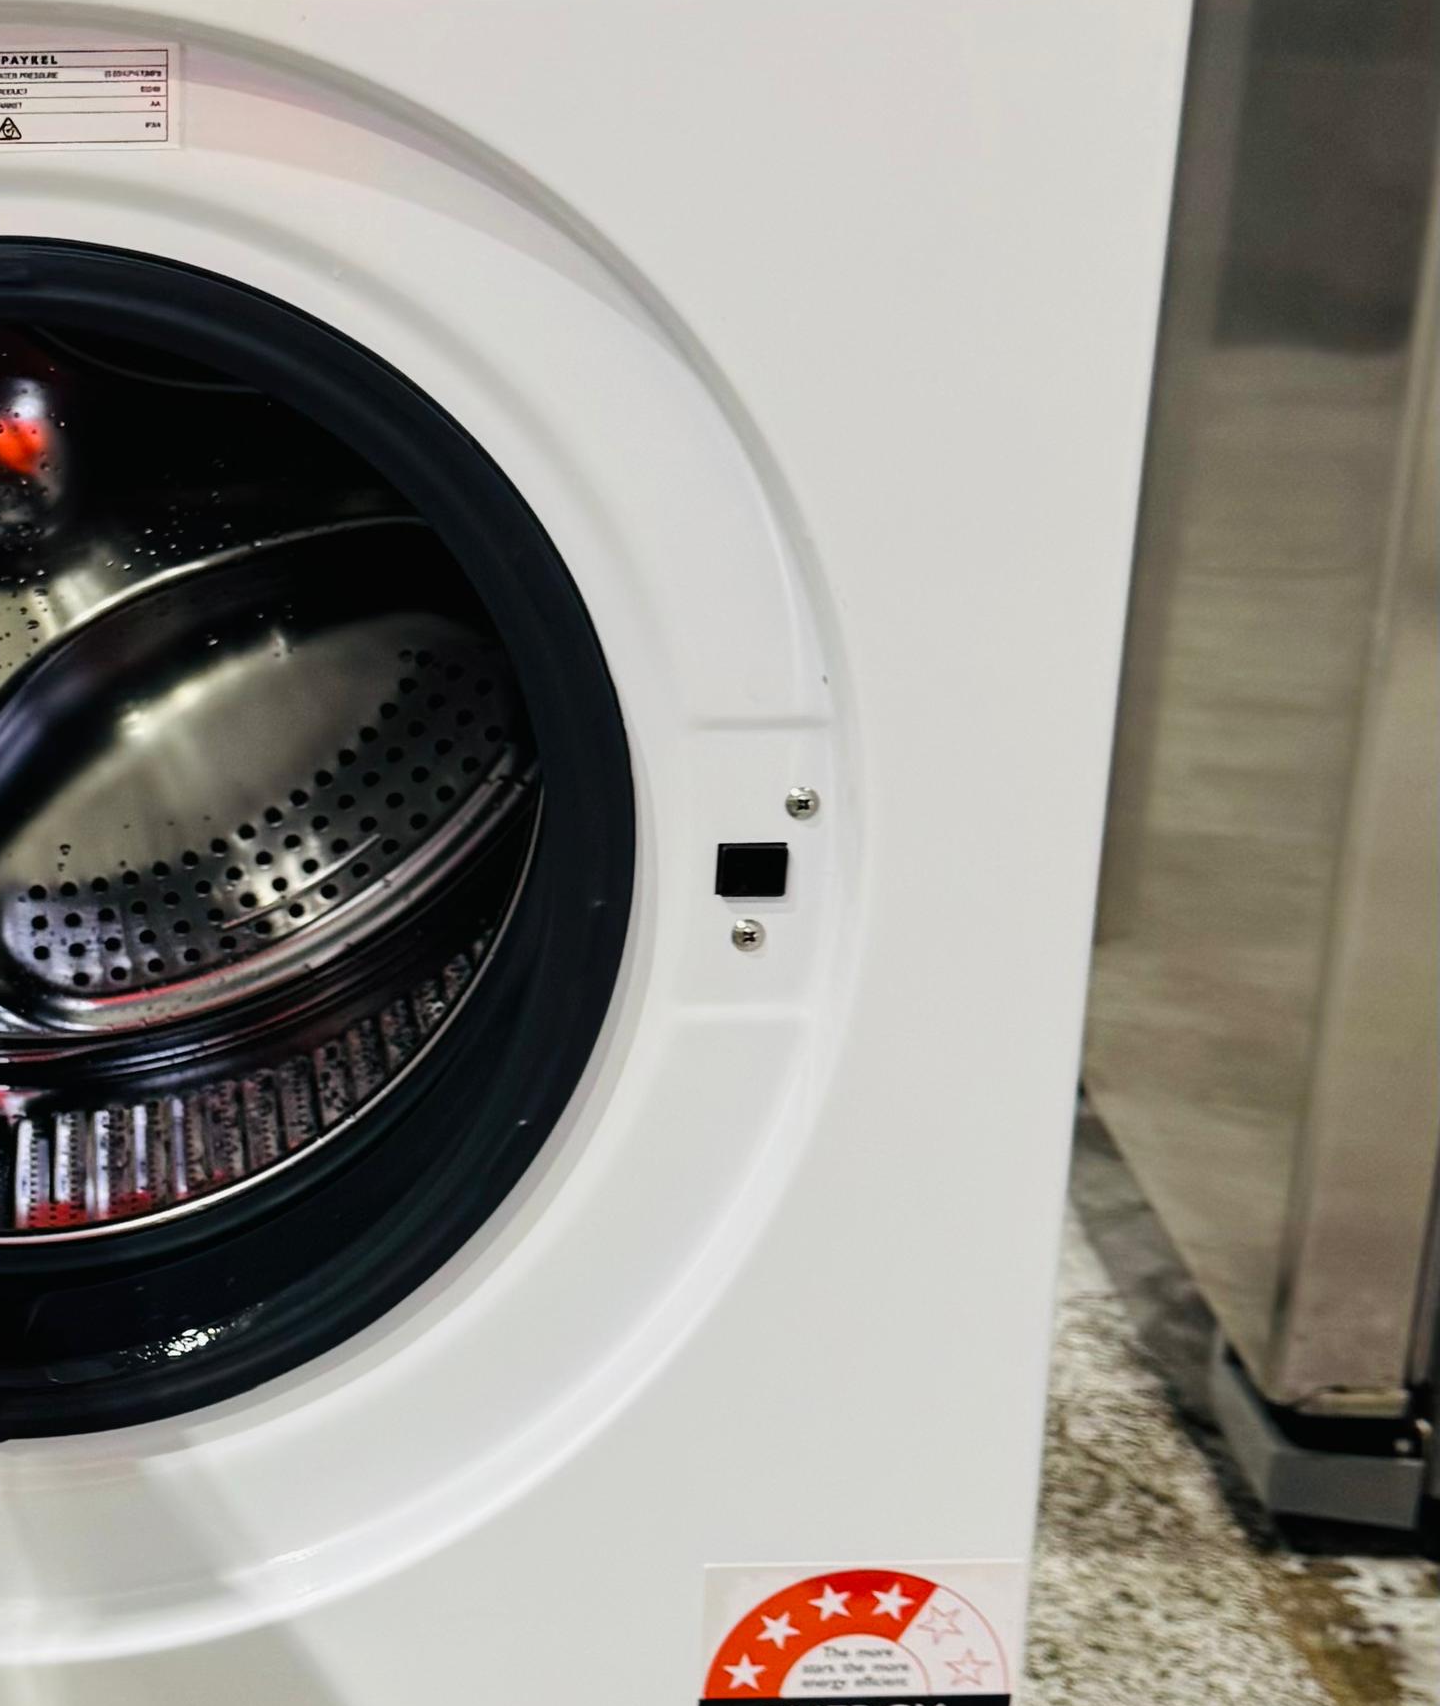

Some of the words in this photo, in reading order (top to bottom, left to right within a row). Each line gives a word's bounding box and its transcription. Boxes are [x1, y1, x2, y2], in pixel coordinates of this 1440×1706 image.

[2, 56, 57, 64] PAYKEL
[824, 1646, 848, 1656] The
[856, 1648, 893, 1656] more
[843, 1663, 864, 1672] the
[801, 1680, 846, 1690] energy
